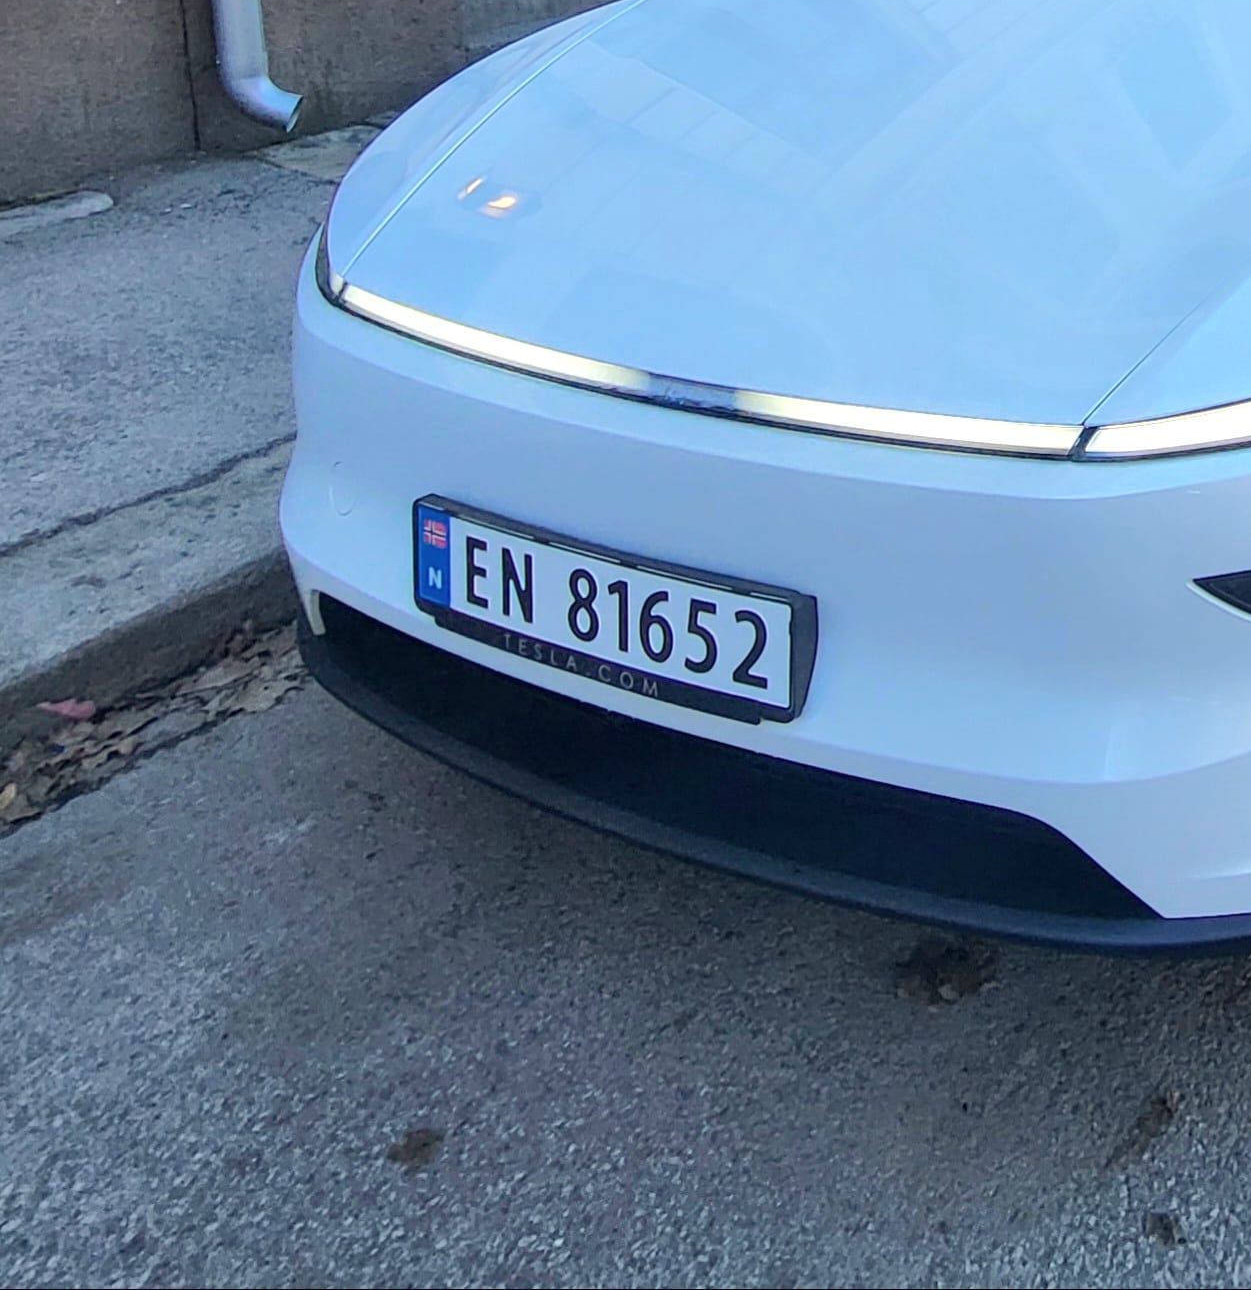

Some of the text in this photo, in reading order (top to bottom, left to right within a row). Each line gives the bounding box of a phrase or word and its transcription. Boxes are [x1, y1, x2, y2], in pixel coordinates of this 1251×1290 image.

[428, 566, 442, 590] N
[465, 535, 769, 690] EN 81652
[503, 633, 659, 698] TESLA.COM
